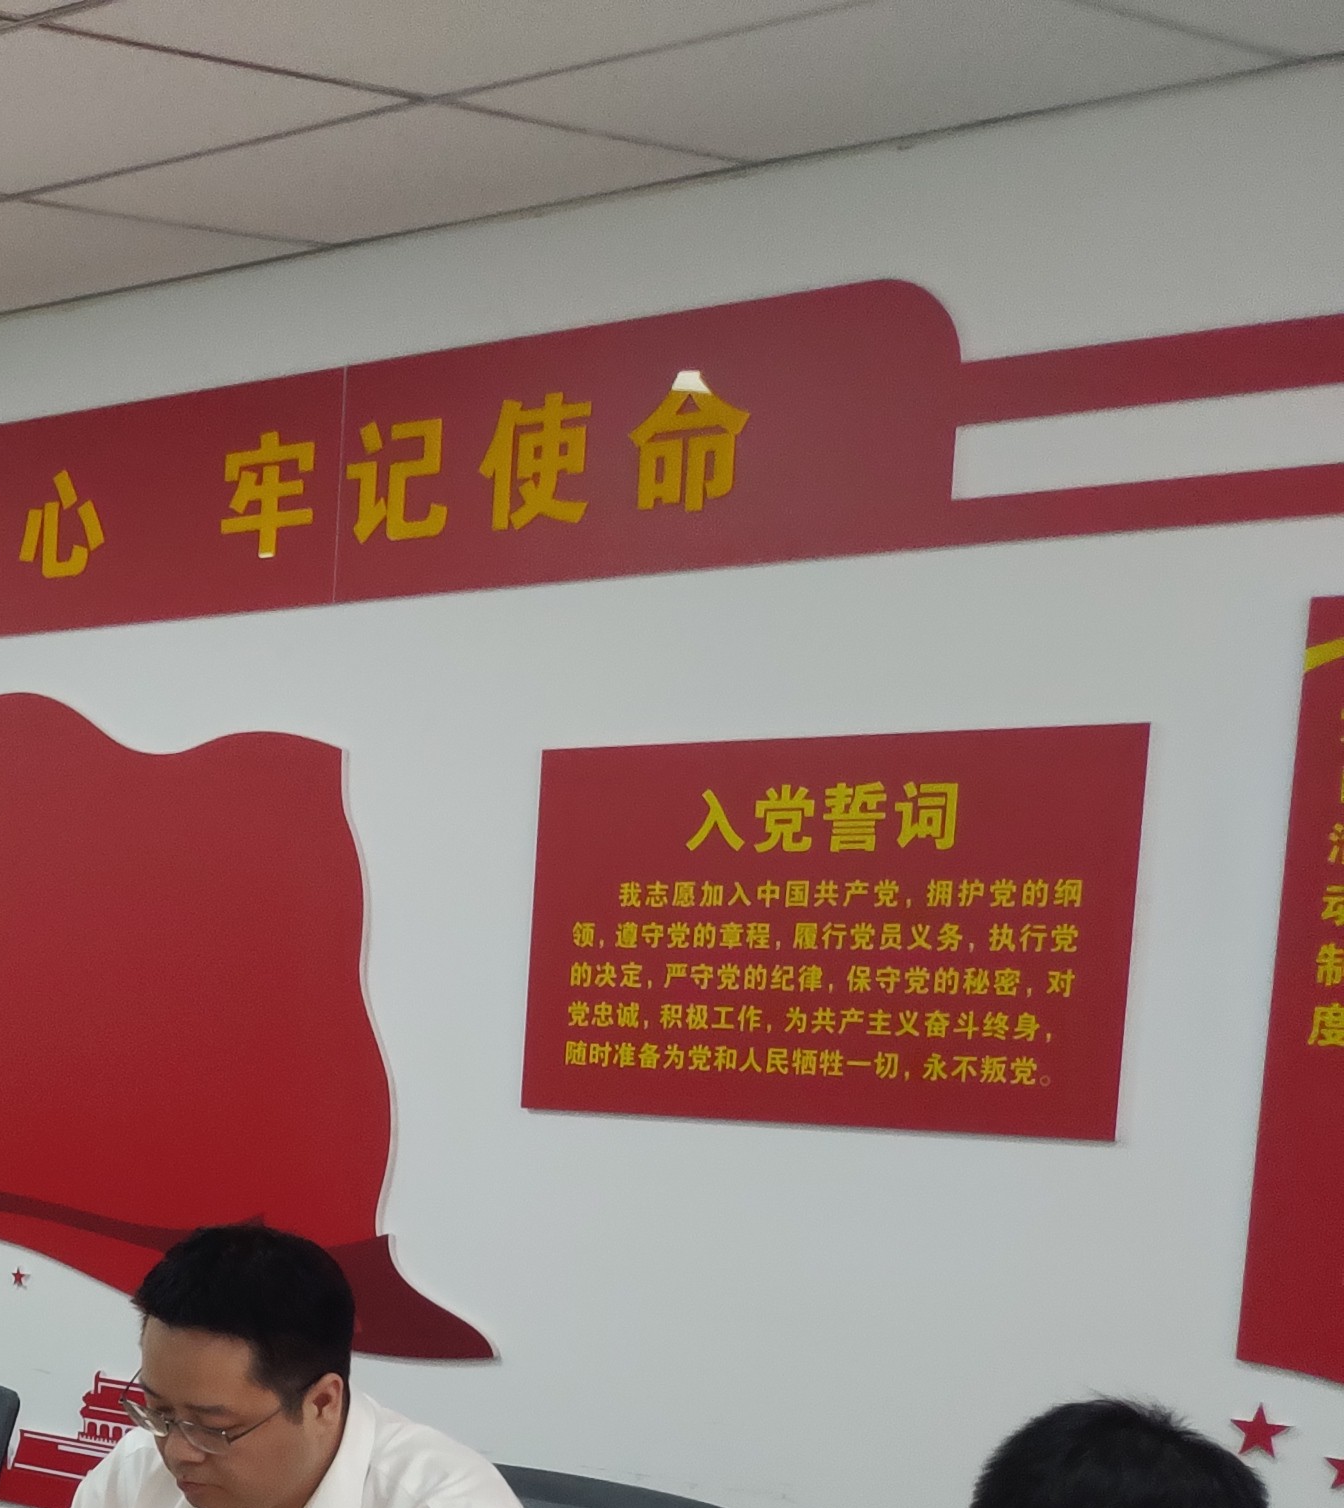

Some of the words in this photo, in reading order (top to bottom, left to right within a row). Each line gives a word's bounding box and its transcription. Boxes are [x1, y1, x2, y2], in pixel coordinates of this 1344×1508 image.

[219, 371, 751, 558] 牢记使命
[686, 780, 960, 854] 入党誓词
